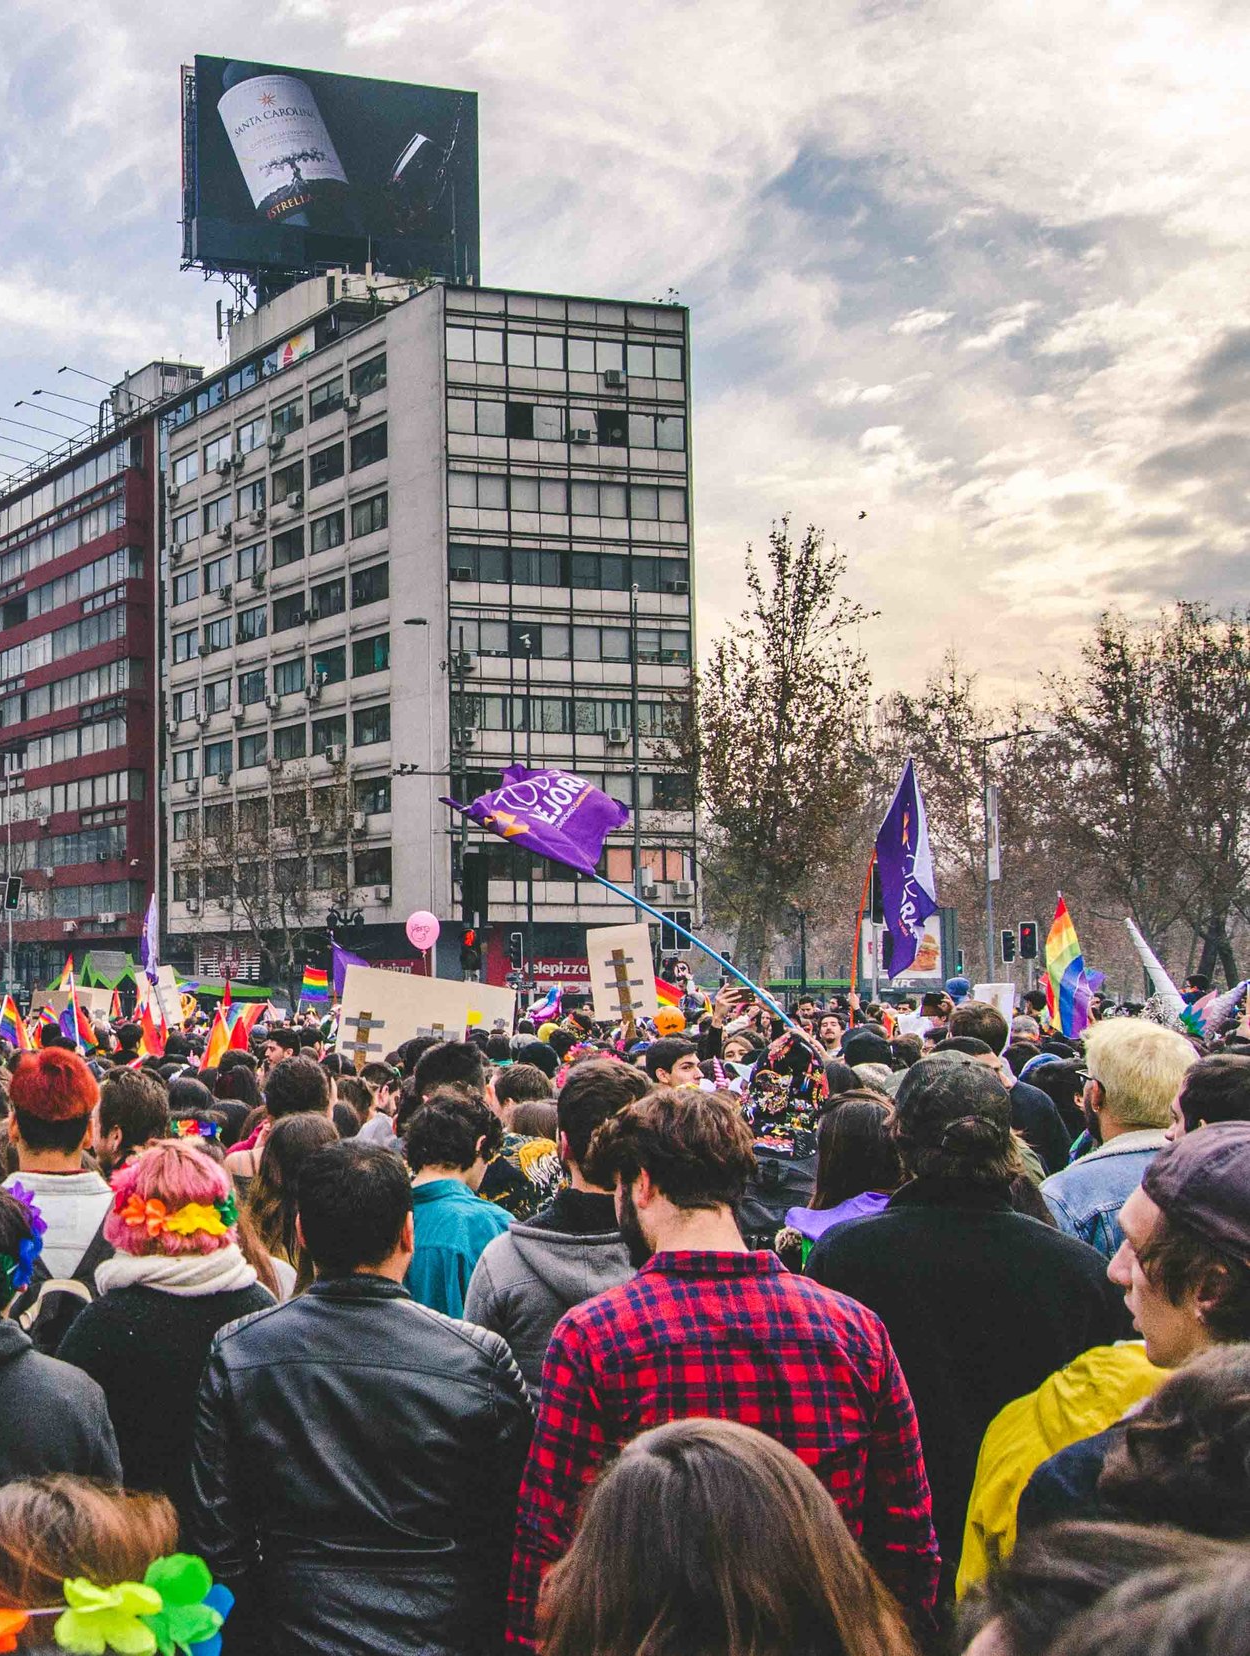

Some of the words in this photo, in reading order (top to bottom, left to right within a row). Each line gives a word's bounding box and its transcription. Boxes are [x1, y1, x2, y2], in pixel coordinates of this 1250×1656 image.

[235, 115, 262, 137] SANTA
[529, 776, 589, 825] EJORA
[524, 961, 589, 977] telepizza
[892, 979, 916, 988] KFC
